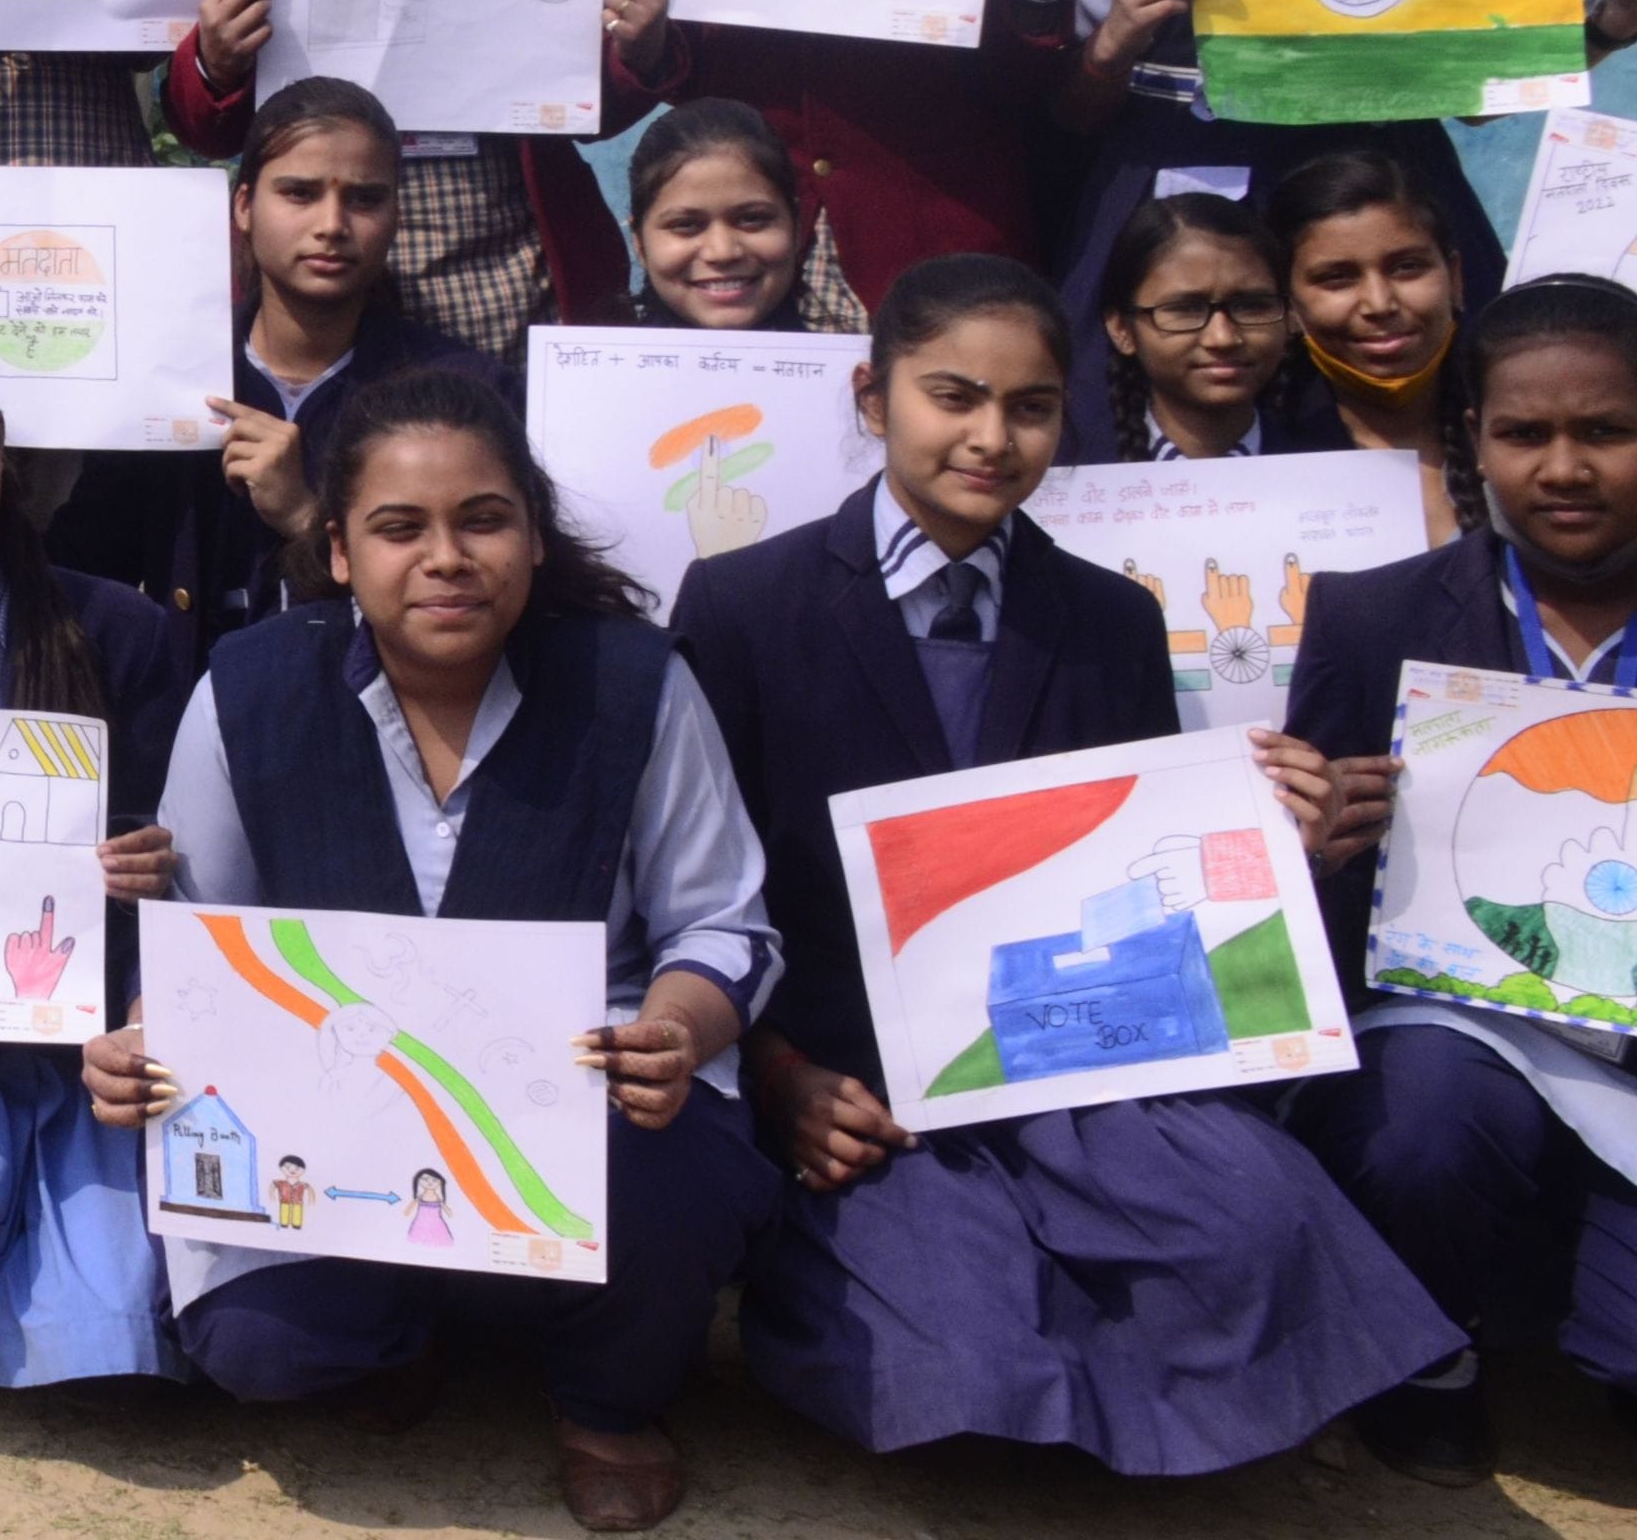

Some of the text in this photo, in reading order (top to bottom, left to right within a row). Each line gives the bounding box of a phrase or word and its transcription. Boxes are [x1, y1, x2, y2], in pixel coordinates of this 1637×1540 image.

[0, 247, 83, 276] मतदाता
[772, 360, 827, 378] मतदान
[1025, 1001, 1103, 1030] VOTE
[1095, 1023, 1149, 1050] BOX
